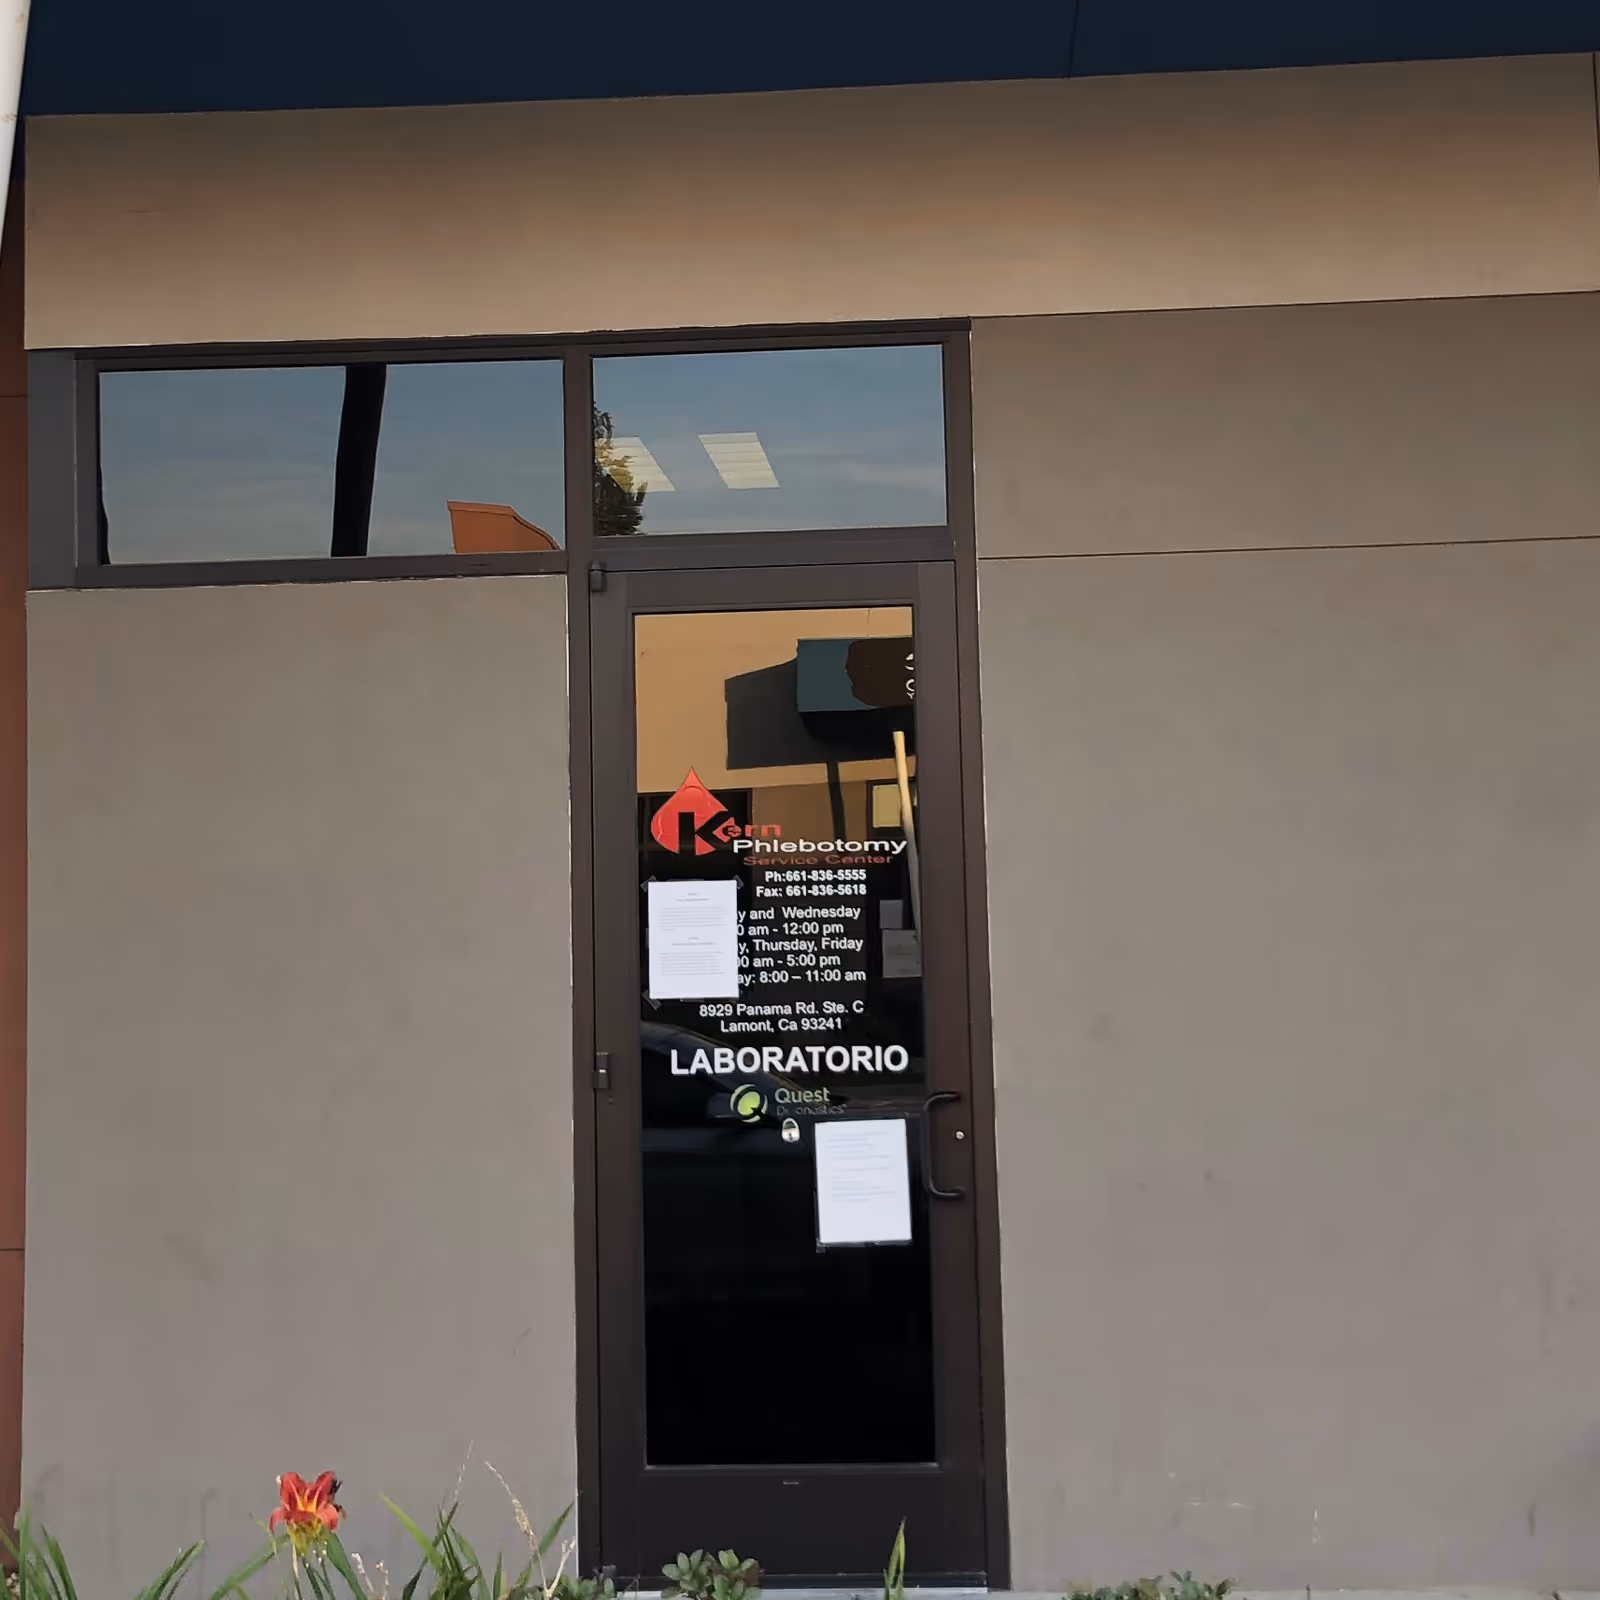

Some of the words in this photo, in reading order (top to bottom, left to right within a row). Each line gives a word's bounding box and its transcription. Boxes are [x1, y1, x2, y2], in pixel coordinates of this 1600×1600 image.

[733, 839, 907, 854] Phlebotomy
[743, 855, 818, 866] Service
[825, 855, 893, 864] Center
[765, 869, 867, 882] Ph:661-836-5555
[756, 886, 783, 897] Fax:
[786, 884, 867, 896] 661-836-5618
[749, 907, 775, 919] and
[781, 905, 861, 919] Wednesday
[748, 925, 769, 935] am
[782, 922, 820, 934] 12:00
[822, 923, 844, 935] pm
[752, 939, 818, 952] Thursday,
[821, 936, 863, 951] Friday
[752, 957, 774, 967] am
[786, 954, 816, 966] 5:00
[819, 955, 841, 967] pm
[759, 970, 789, 983] 8:00
[805, 969, 841, 982] 11:00
[844, 970, 866, 981] am
[699, 1004, 733, 1017] 8929
[736, 1003, 792, 1016] Panama
[795, 1001, 819, 1014] Rd.
[822, 1001, 849, 1014] Ste.
[852, 1000, 865, 1013] C
[720, 1020, 774, 1033] Lamont,
[777, 1019, 798, 1031] Ca
[801, 1017, 842, 1030] 93241
[670, 1045, 909, 1075] LABORATORIO
[774, 1086, 831, 1104] Quest
